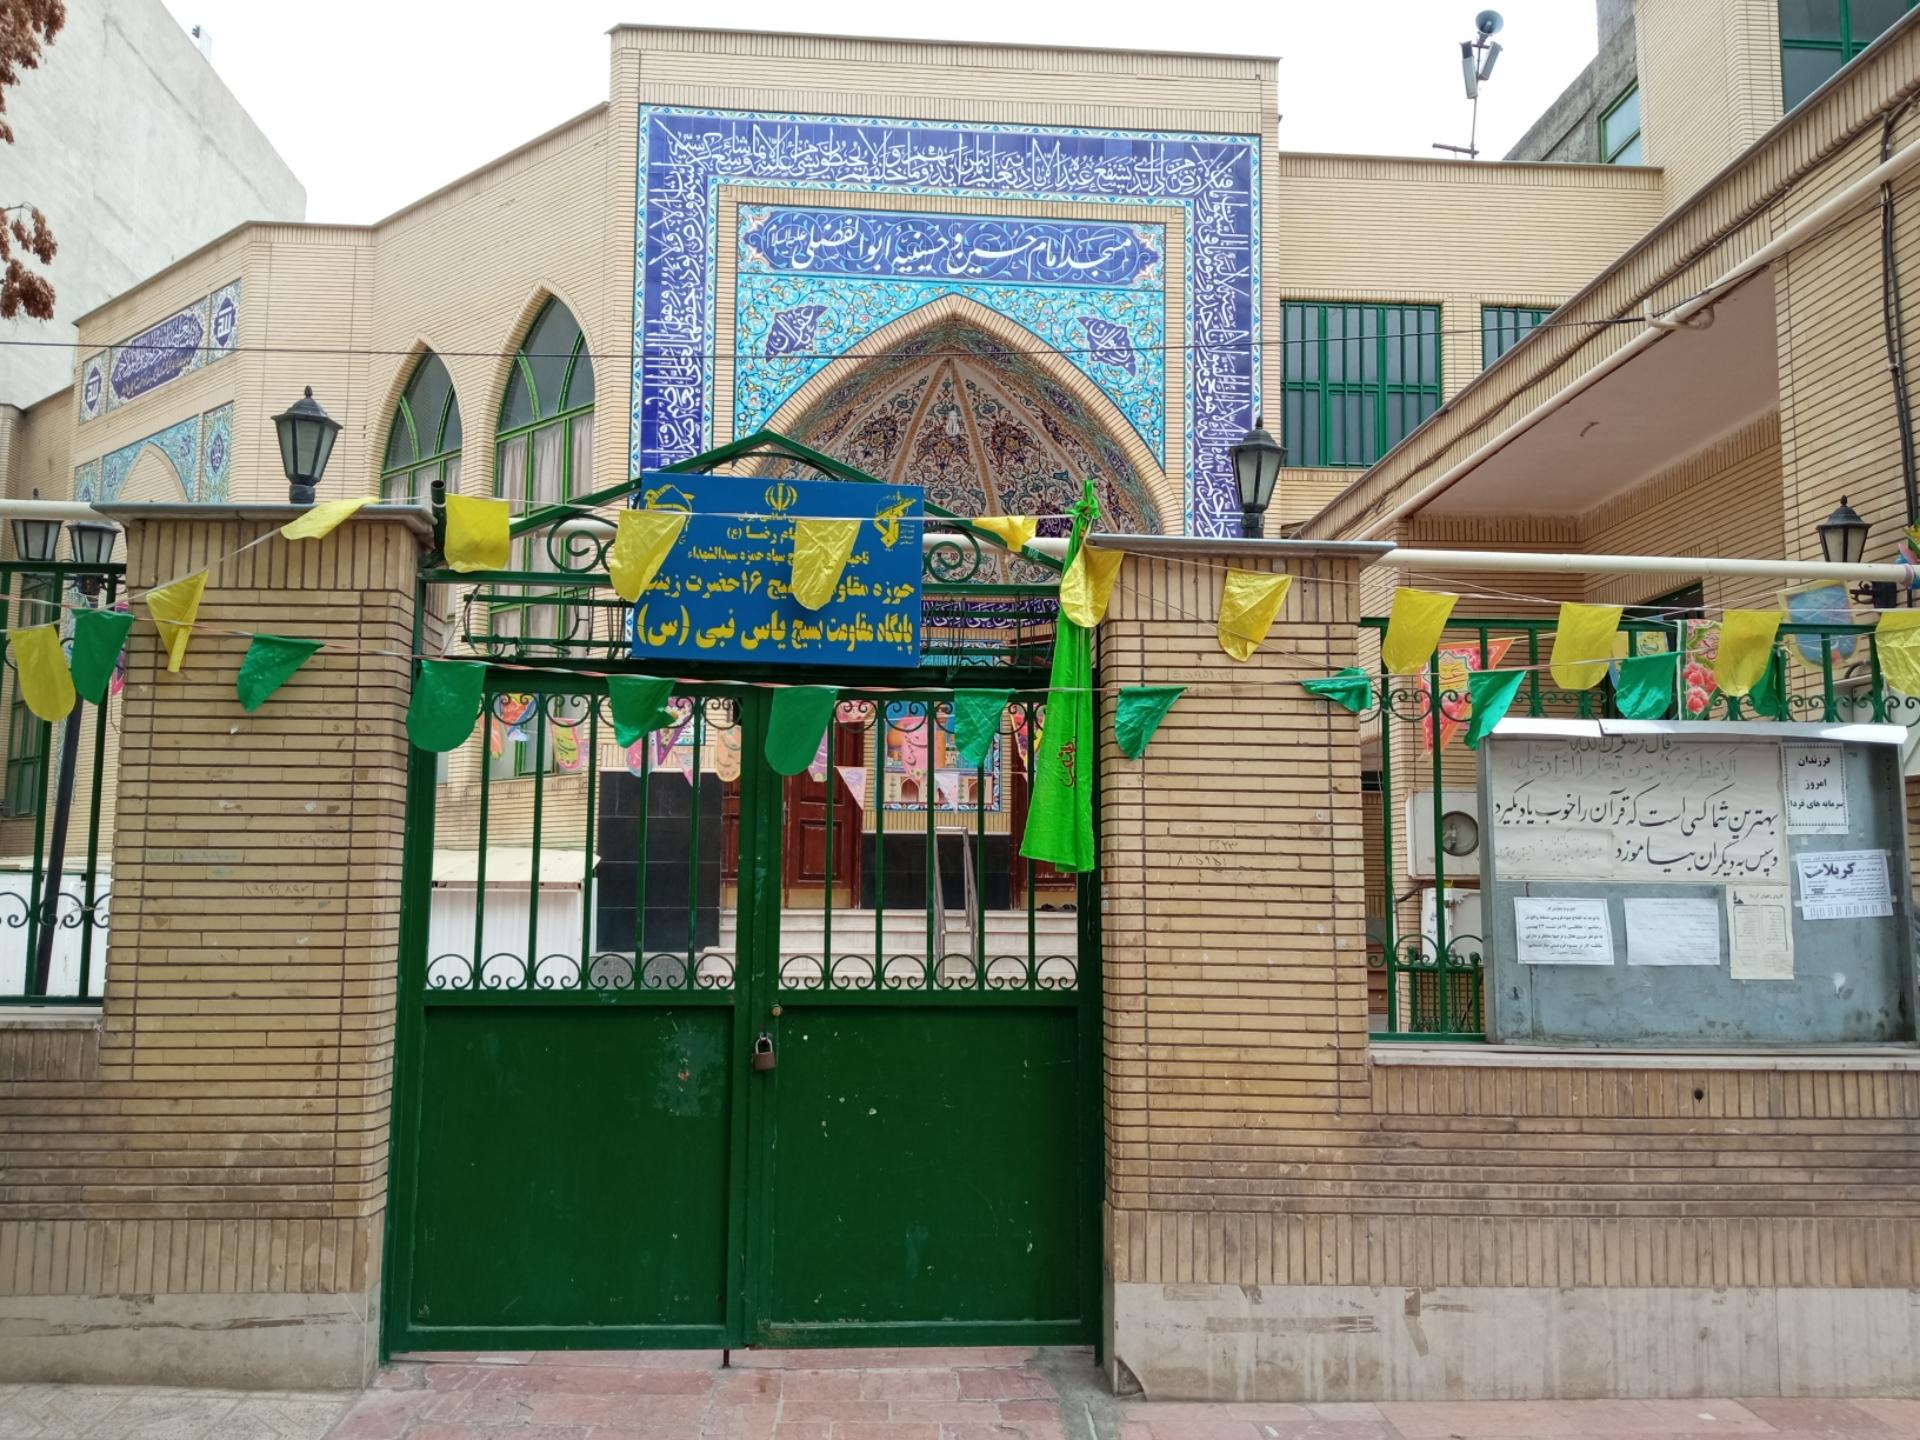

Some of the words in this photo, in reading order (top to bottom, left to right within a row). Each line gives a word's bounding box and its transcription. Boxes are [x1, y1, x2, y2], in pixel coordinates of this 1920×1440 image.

[947, 234, 1038, 275] حسین
[1027, 233, 1068, 280] امام
[1057, 232, 1132, 277] مسجد
[745, 525, 777, 545] رضا
[766, 547, 786, 567] سپاه
[684, 571, 740, 599] حضرت
[872, 582, 915, 605] حوزه
[636, 603, 691, 647] (س)
[695, 608, 736, 649] نبی
[740, 609, 787, 651] یاس
[791, 619, 823, 650] بسیج
[826, 611, 875, 652] مقاومت
[877, 611, 914, 656] پایگاه
[1798, 755, 1831, 767] فرزندان
[1805, 778, 1827, 790] امروز
[1534, 793, 1577, 825] خوب
[1579, 794, 1588, 823] را
[1589, 787, 1631, 826] قرآن
[1625, 782, 1661, 826] که
[1638, 796, 1685, 828] است
[1680, 782, 1736, 837] کسی
[1712, 800, 1729, 829] شما
[1806, 799, 1821, 810] های
[1727, 808, 1779, 840] بهترین
[1693, 839, 1741, 876] دیگران
